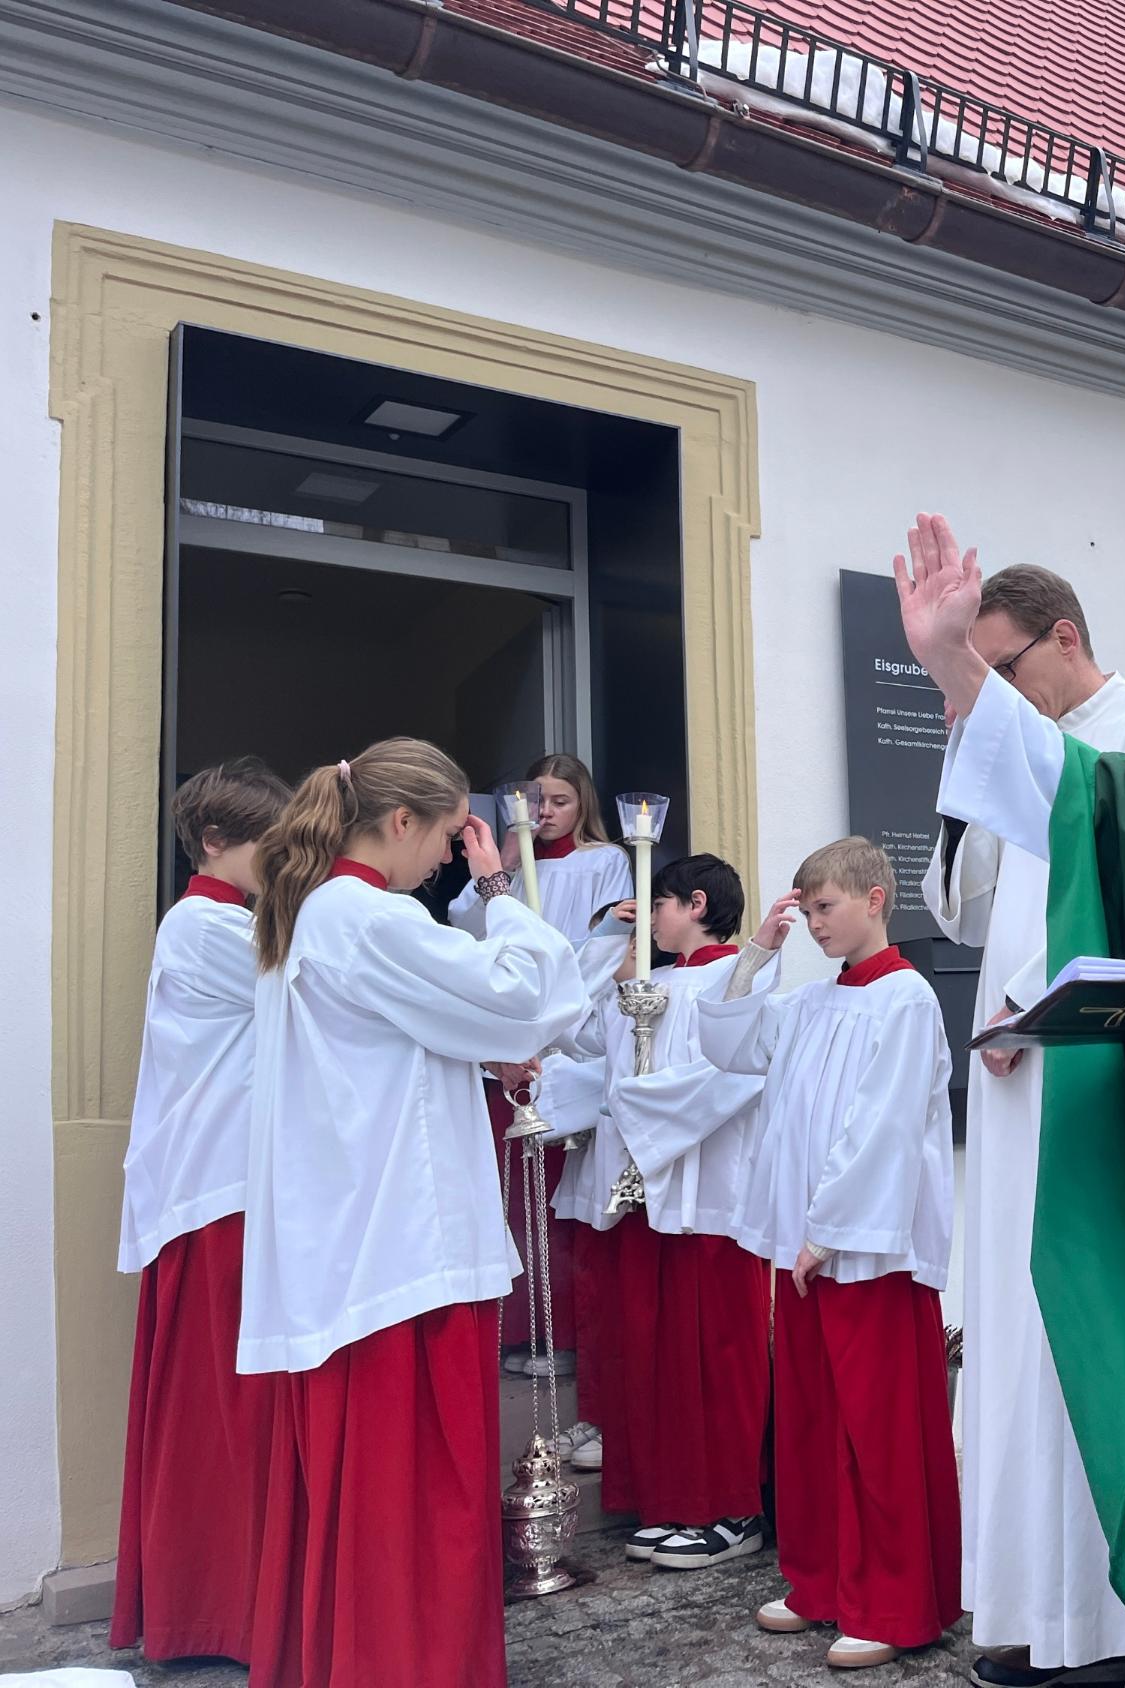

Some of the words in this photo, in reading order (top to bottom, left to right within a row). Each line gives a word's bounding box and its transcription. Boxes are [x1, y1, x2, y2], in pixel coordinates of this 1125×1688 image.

[896, 709, 917, 718] Unsere
[893, 723, 945, 735] Seelsorgebereich
[895, 738, 947, 751] Gesamtkircheng
[897, 843, 935, 852] Kirchenstiftun
